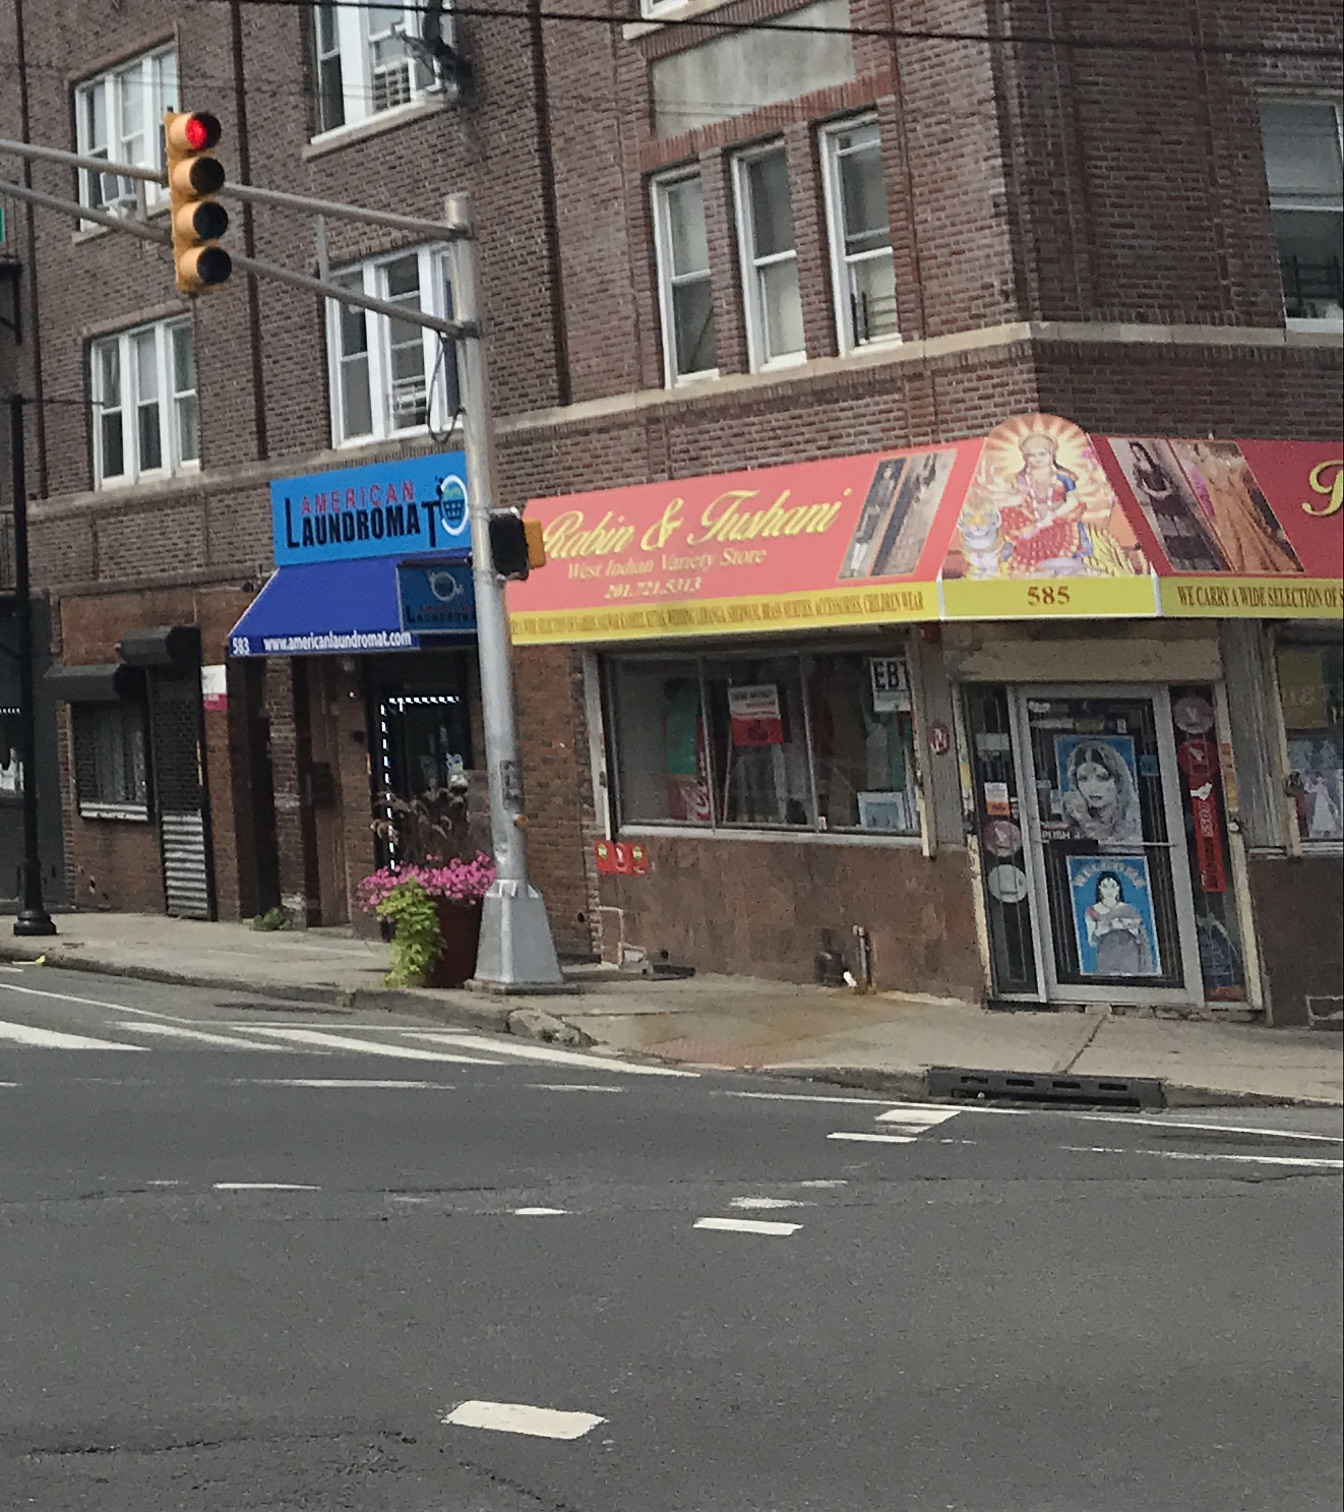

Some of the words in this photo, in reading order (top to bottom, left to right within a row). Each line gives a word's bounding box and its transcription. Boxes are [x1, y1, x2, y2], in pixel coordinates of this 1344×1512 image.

[301, 481, 415, 513] AMERICAN
[284, 497, 442, 548] LAUNDROMAT
[640, 497, 684, 551] &
[568, 562, 603, 580] West
[661, 552, 713, 573] Variety
[720, 547, 767, 566] Store
[1027, 585, 1070, 606] 585
[1177, 586, 1194, 606] WE
[1196, 586, 1230, 607] CARRY
[1232, 587, 1239, 607] A
[1238, 586, 1265, 607] WIDE
[1268, 587, 1323, 608] SELECTION
[1324, 588, 1338, 608] OF
[231, 637, 250, 655] 583
[263, 629, 413, 651] www.americanlaundromat.com
